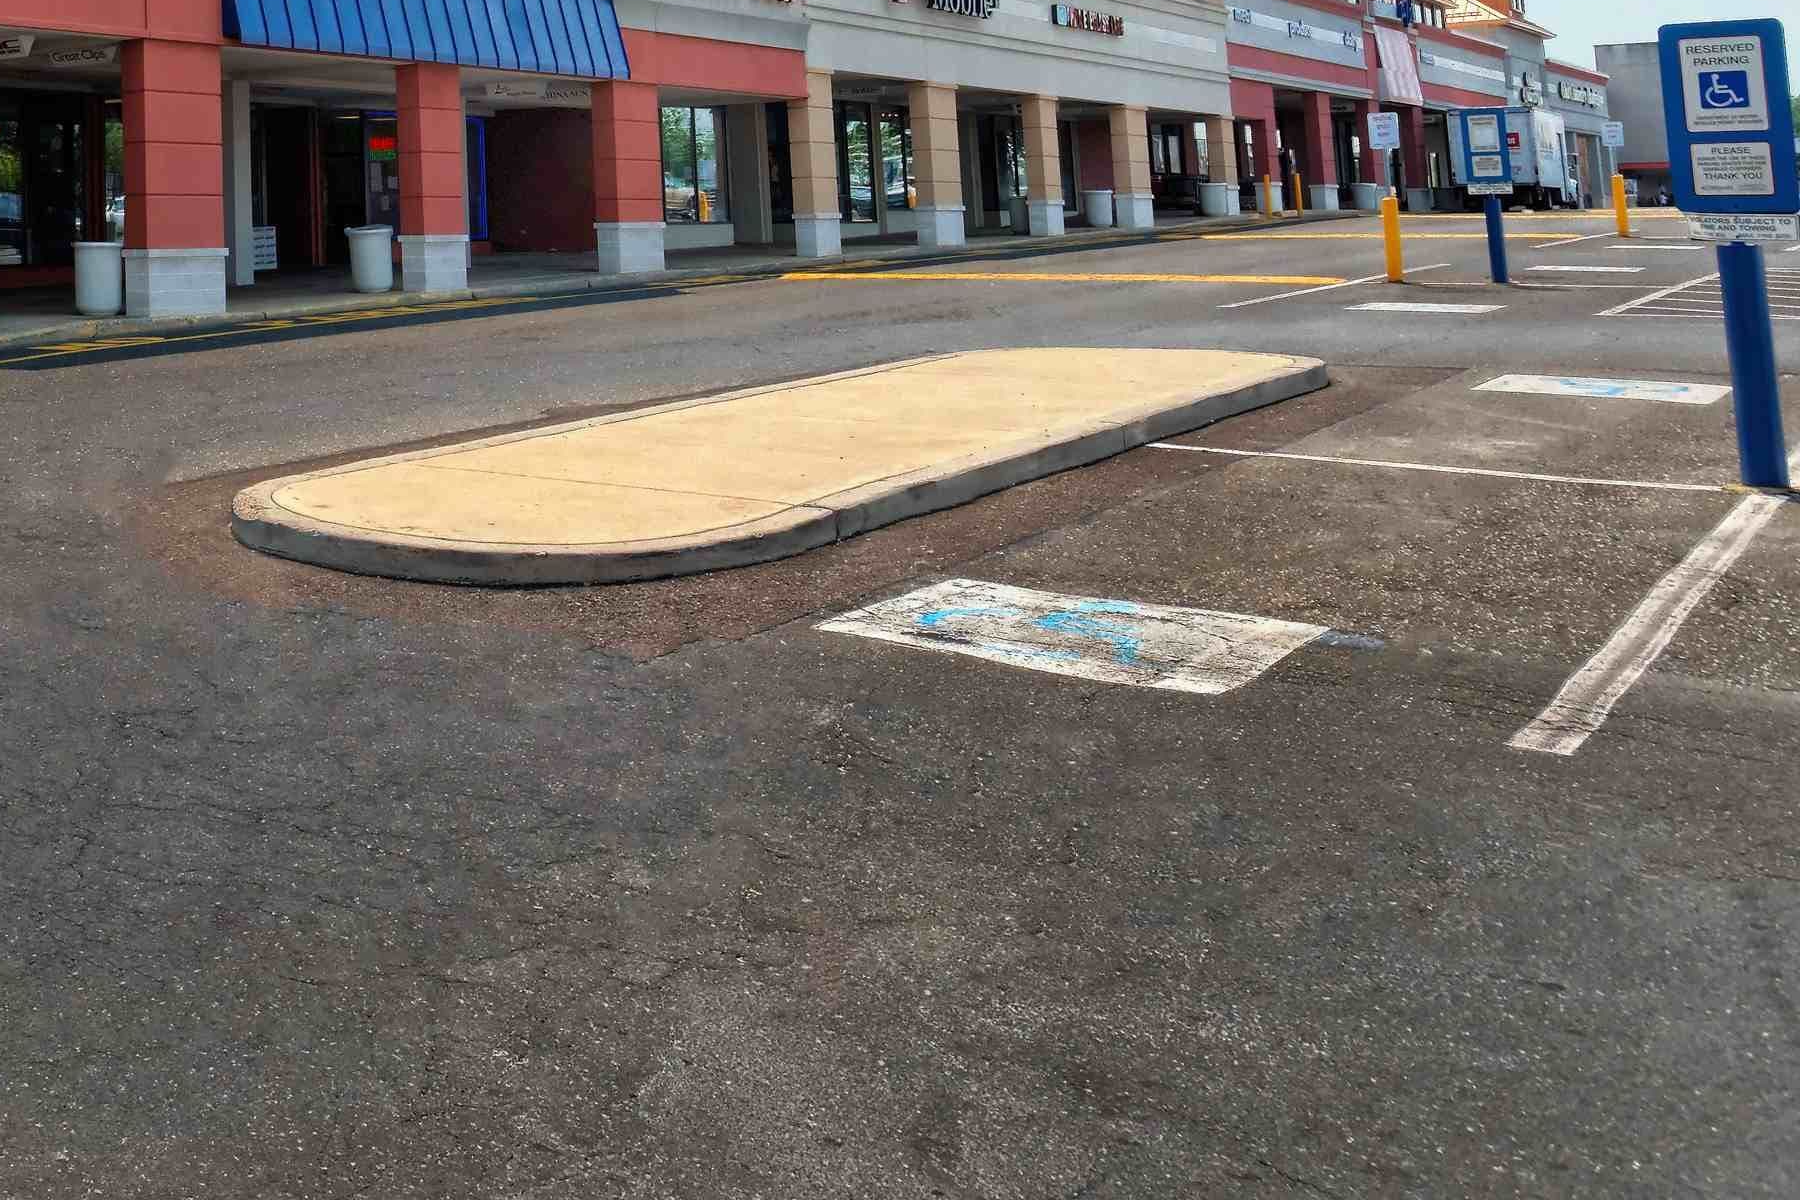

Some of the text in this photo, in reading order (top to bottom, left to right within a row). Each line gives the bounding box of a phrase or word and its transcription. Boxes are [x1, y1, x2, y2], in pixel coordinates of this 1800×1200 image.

[1686, 43, 1755, 55] RESERVED
[1693, 55, 1750, 66] PARKING
[1711, 146, 1752, 155] PLEASE
[1704, 171, 1763, 181] THANK YOU
[1779, 217, 1791, 225] TO
[1718, 223, 1737, 232] AND
